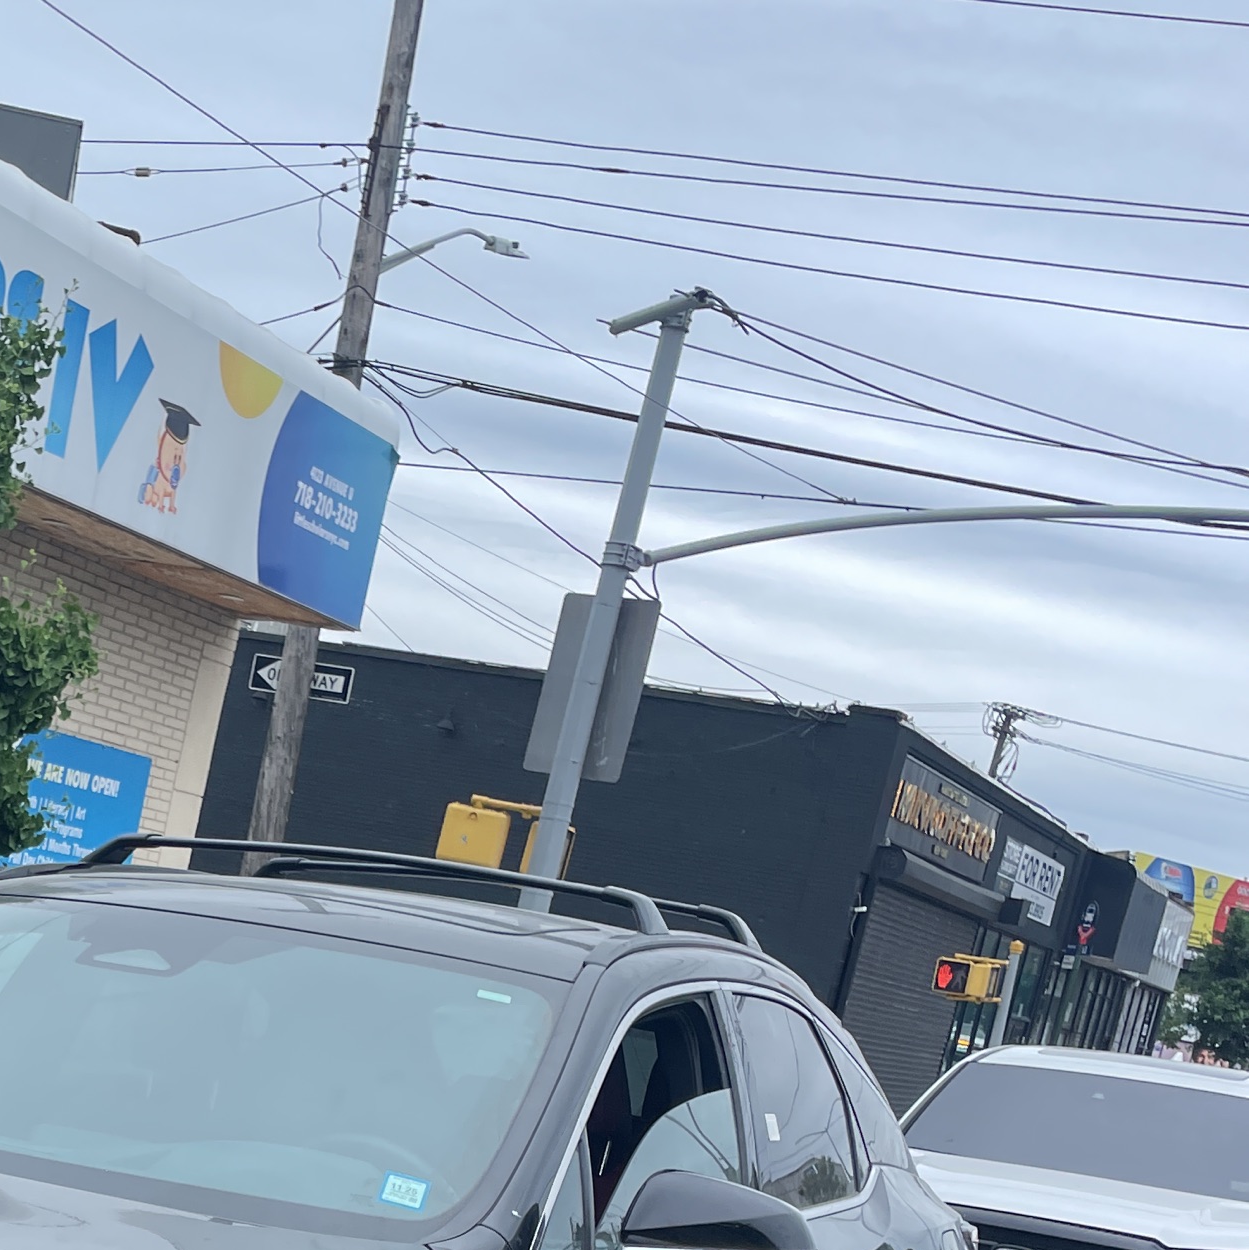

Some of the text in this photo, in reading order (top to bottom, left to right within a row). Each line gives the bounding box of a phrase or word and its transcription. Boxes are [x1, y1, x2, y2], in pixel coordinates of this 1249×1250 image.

[44, 763, 65, 784] ARE
[65, 768, 91, 791] NOW
[91, 775, 121, 798] OPEN!
[1018, 852, 1040, 889] FOR
[1036, 862, 1062, 898] RENT
